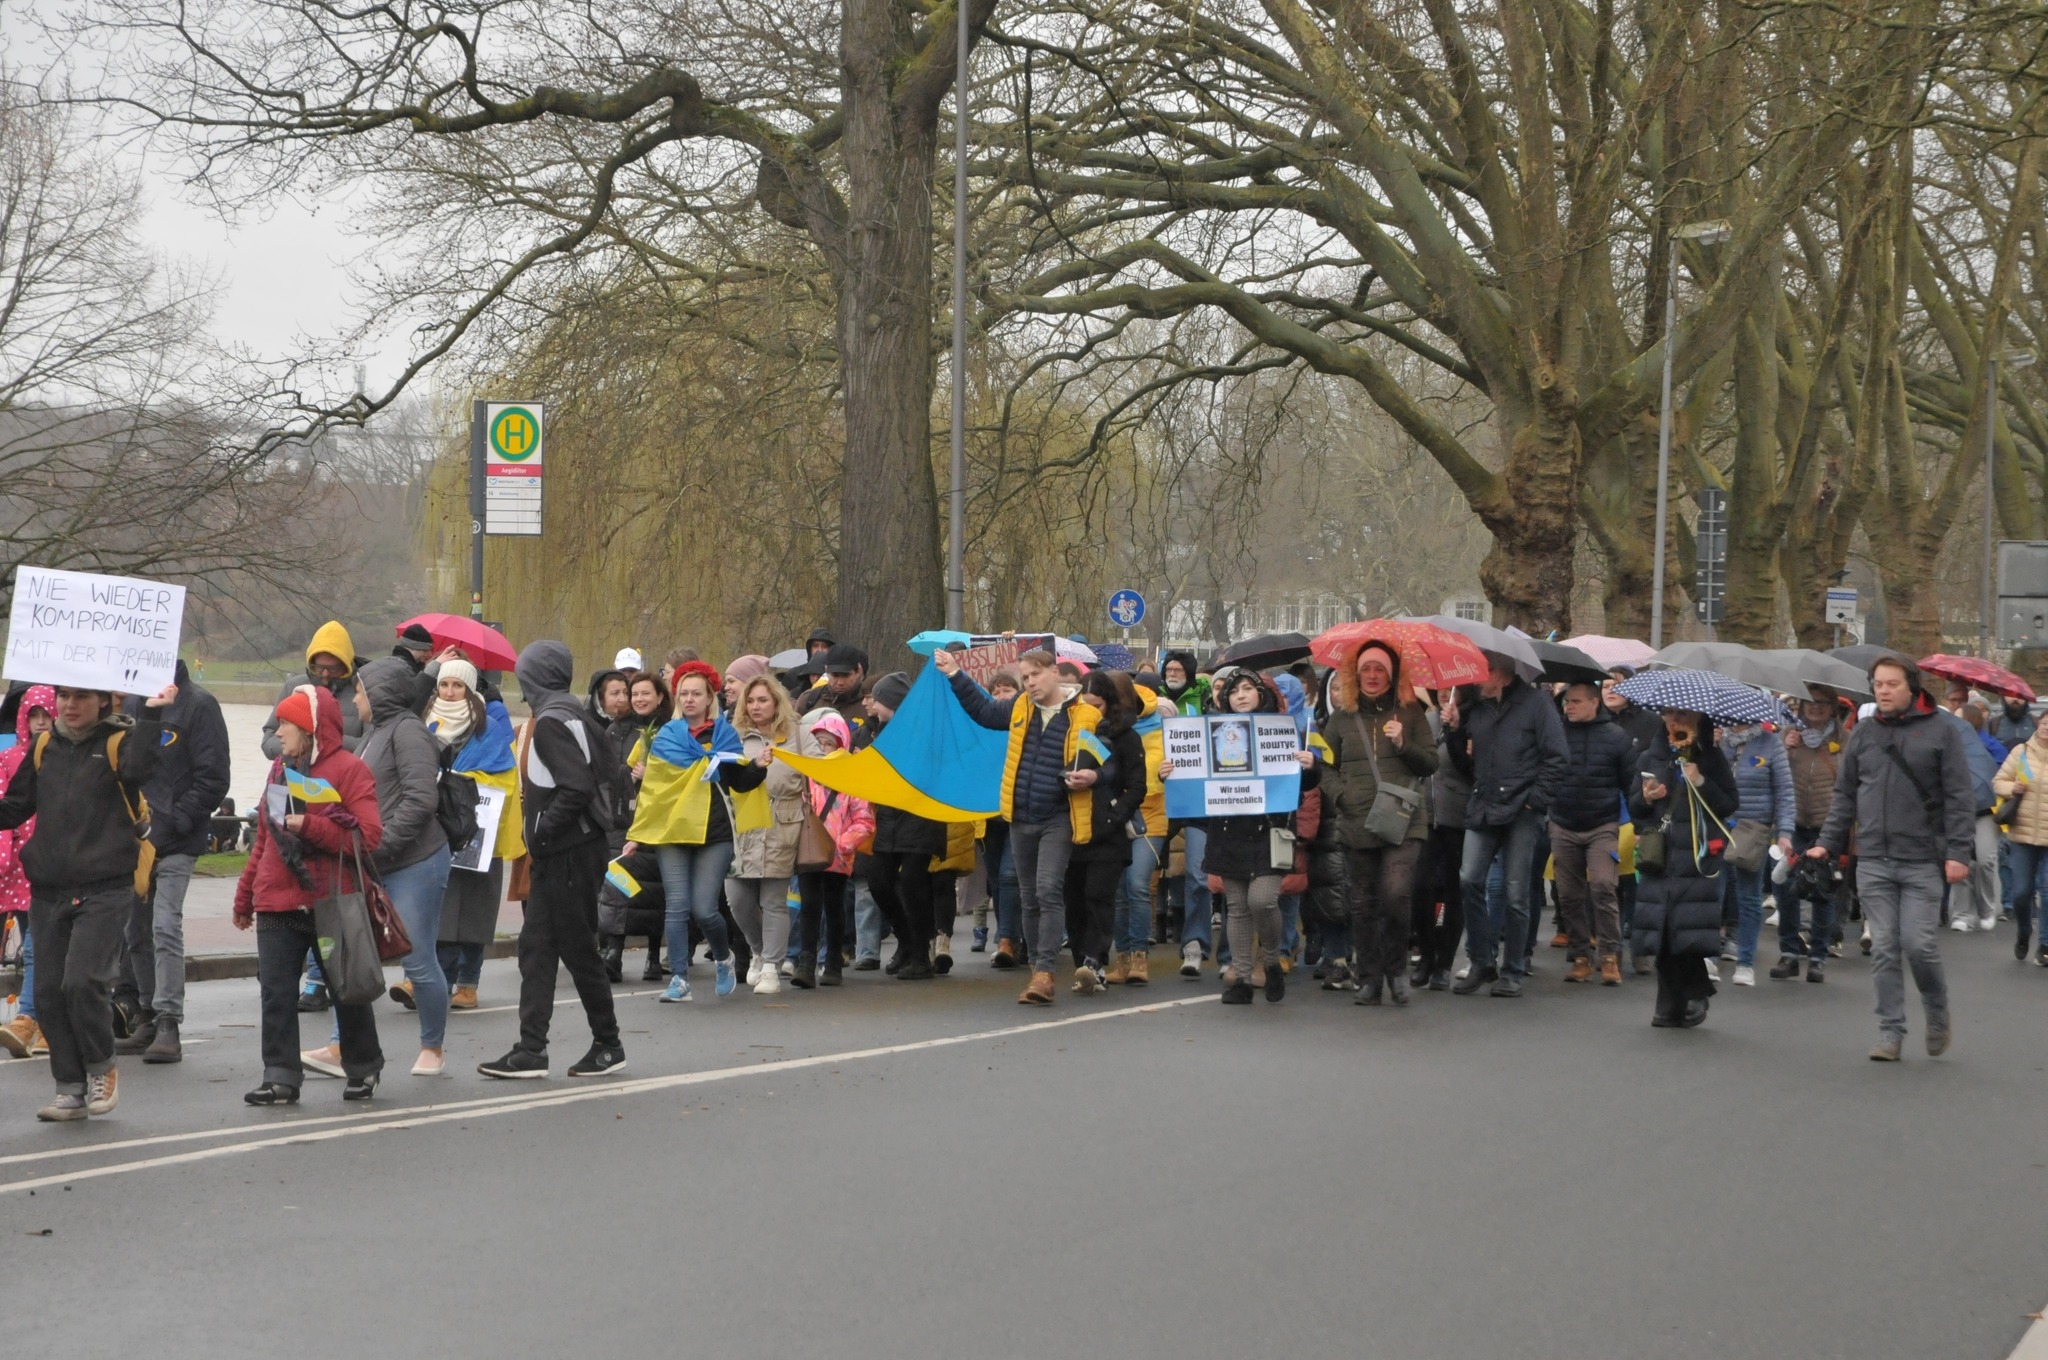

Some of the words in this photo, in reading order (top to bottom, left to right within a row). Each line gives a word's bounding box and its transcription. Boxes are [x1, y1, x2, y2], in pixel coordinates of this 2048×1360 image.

[505, 419, 525, 449] H
[28, 575, 69, 601] NIE
[91, 582, 172, 614] WIEDER
[31, 603, 169, 640] KOMPROMISSE
[11, 638, 55, 660] MIT
[62, 643, 96, 663] DER
[103, 645, 175, 669] TYRANNEI
[953, 643, 1018, 671] RUSSLAND
[1169, 729, 1201, 740] Zörgen
[1258, 727, 1295, 736] Вагання
[1171, 744, 1200, 753] kostet
[1260, 741, 1295, 749] коштує
[1263, 752, 1295, 762] життя!
[1234, 785, 1250, 793] sind
[1208, 796, 1263, 805] unzerbrechlich
